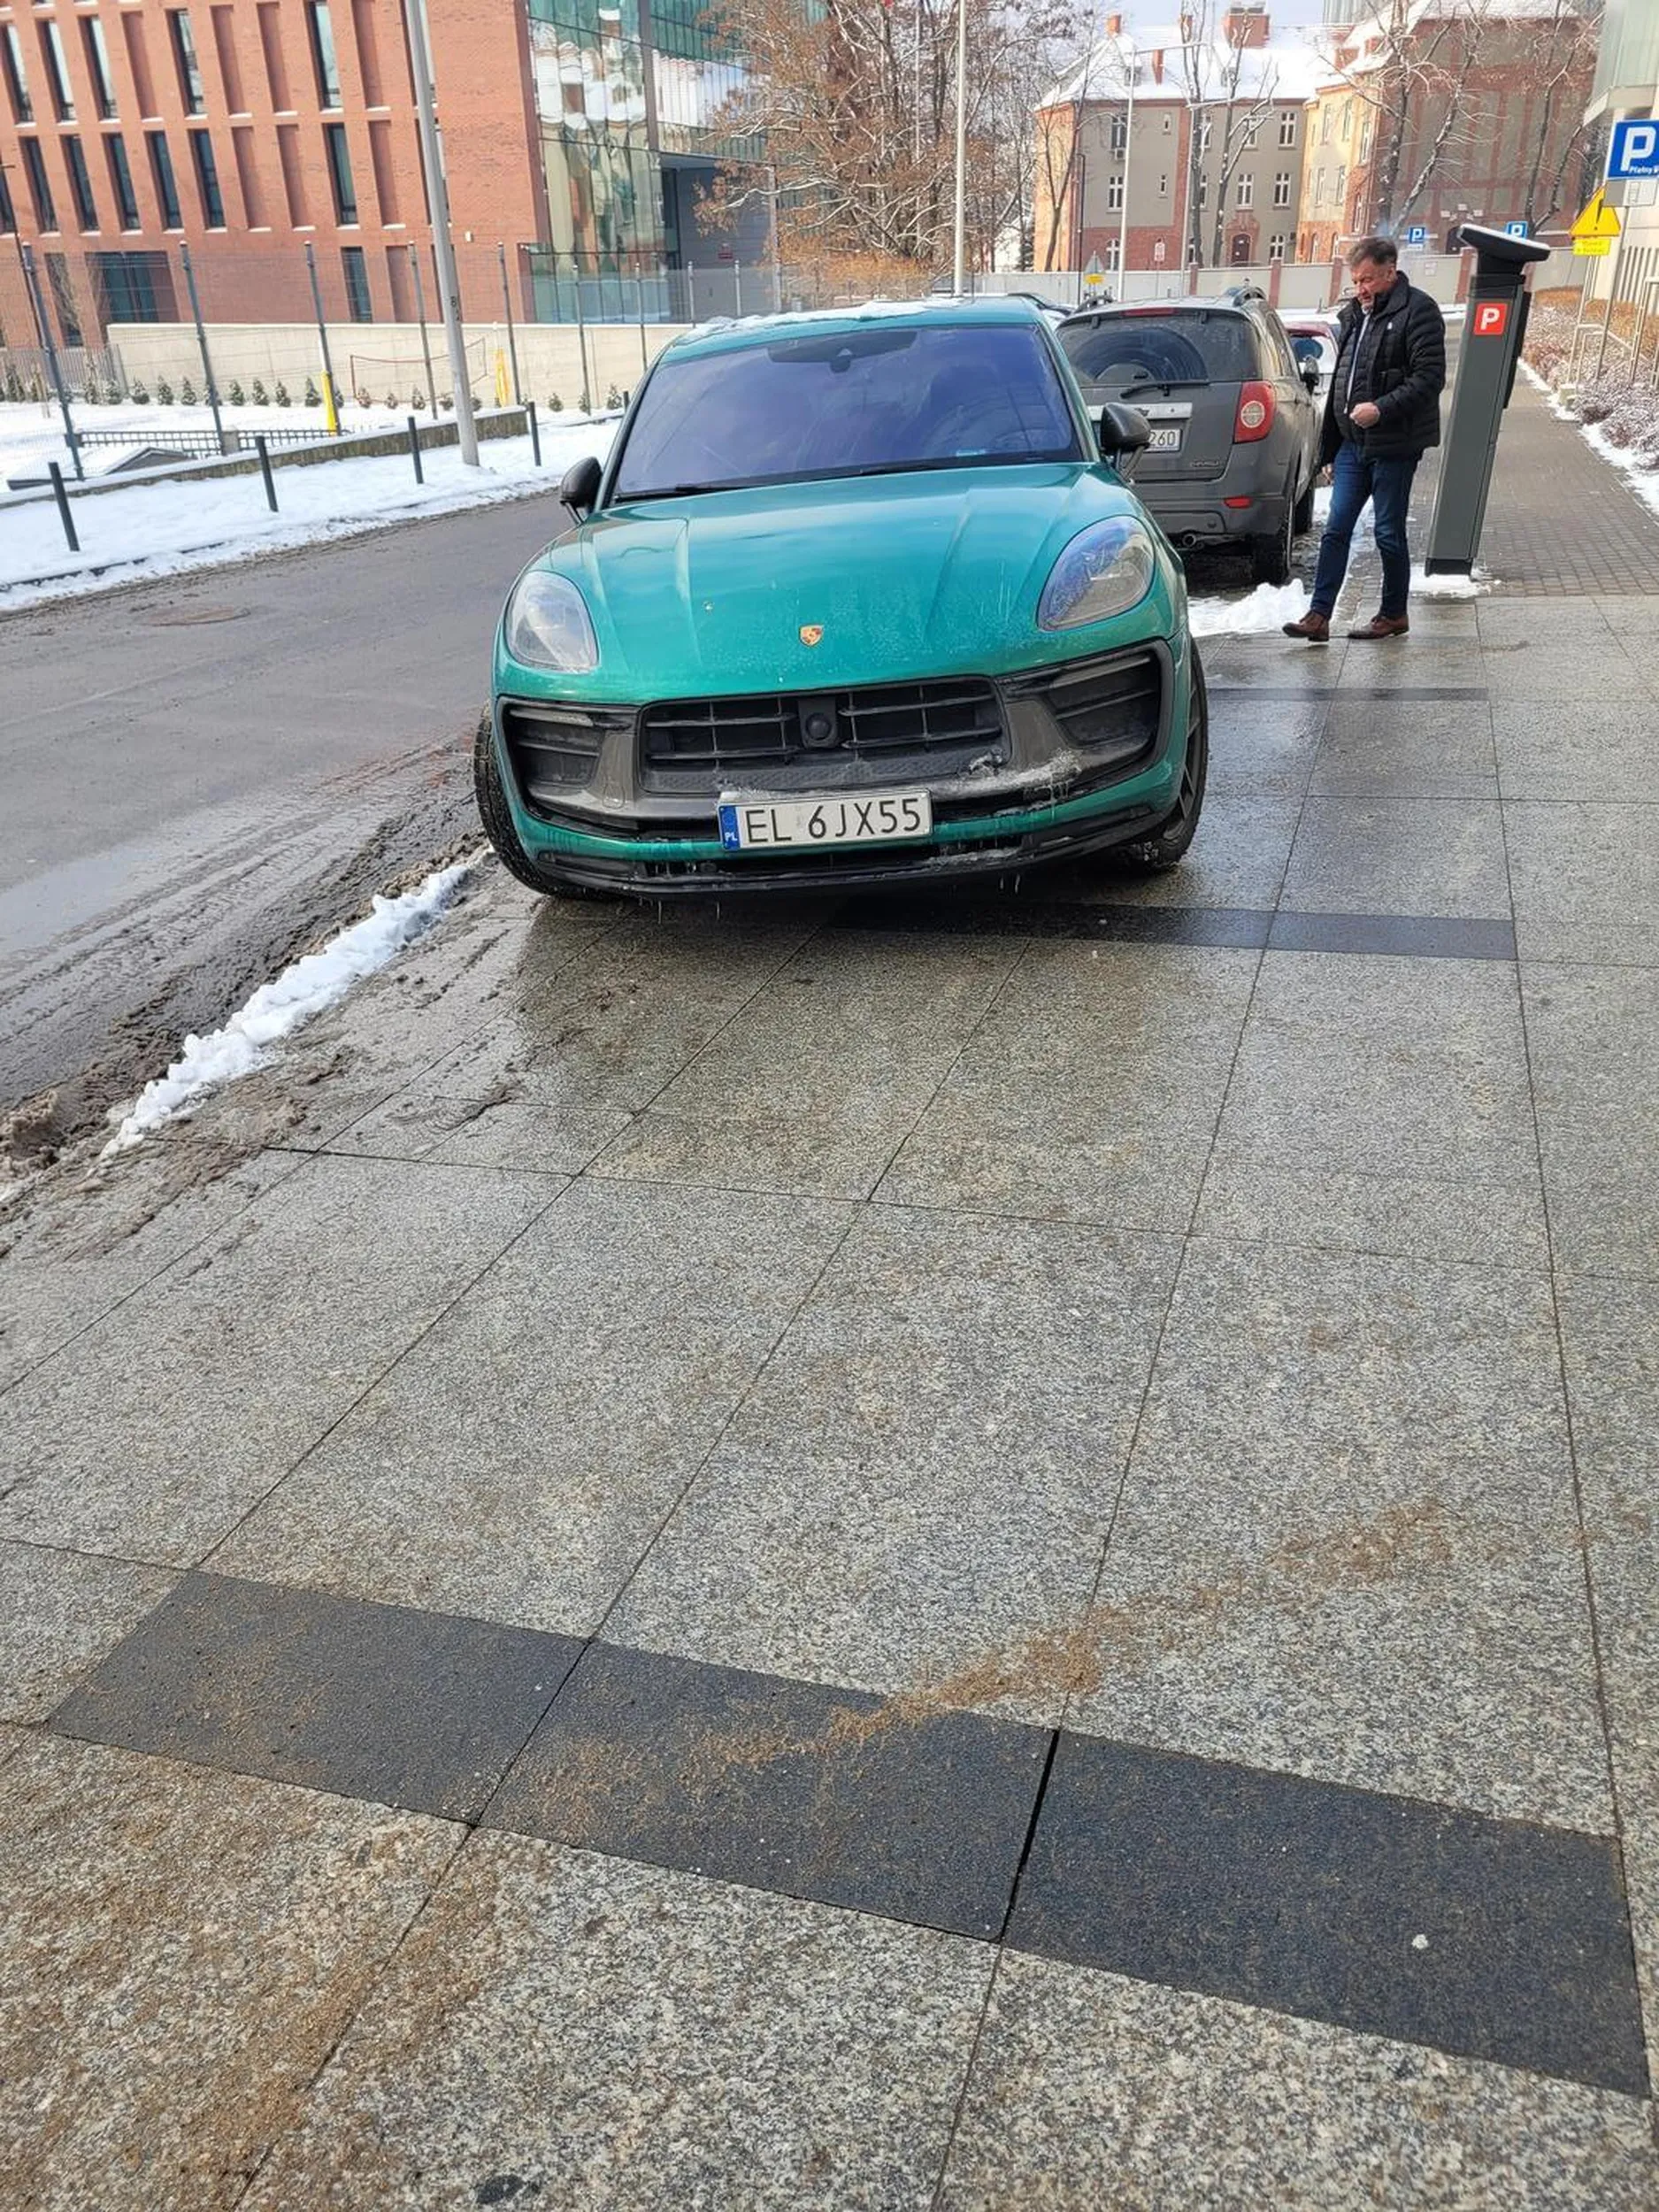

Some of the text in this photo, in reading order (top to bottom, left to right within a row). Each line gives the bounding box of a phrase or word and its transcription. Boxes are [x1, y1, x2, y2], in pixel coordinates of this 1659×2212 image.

[1620, 127, 1656, 172] P
[1411, 227, 1423, 242] P
[1480, 307, 1501, 330] P
[745, 798, 921, 842] EL 6JX55
[725, 832, 738, 841] PL
